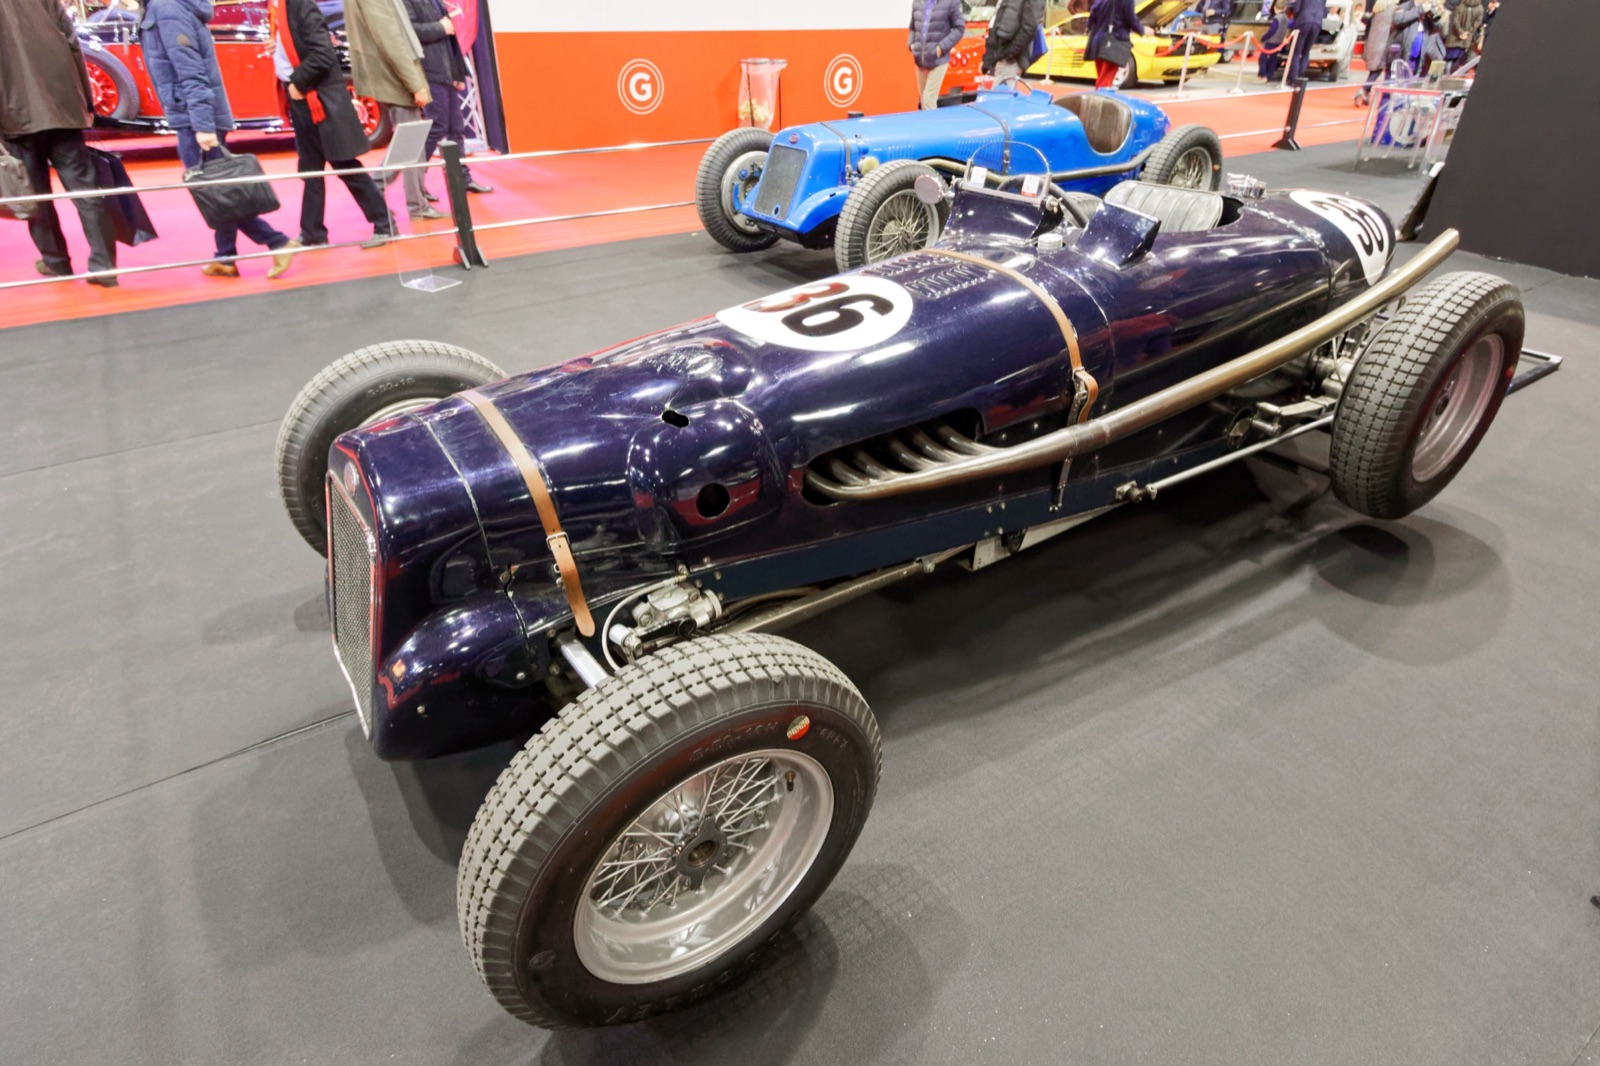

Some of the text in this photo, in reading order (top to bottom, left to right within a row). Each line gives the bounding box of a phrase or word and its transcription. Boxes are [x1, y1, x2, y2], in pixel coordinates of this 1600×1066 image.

[628, 72, 652, 102] G
[833, 66, 853, 95] G
[741, 282, 895, 338] 36
